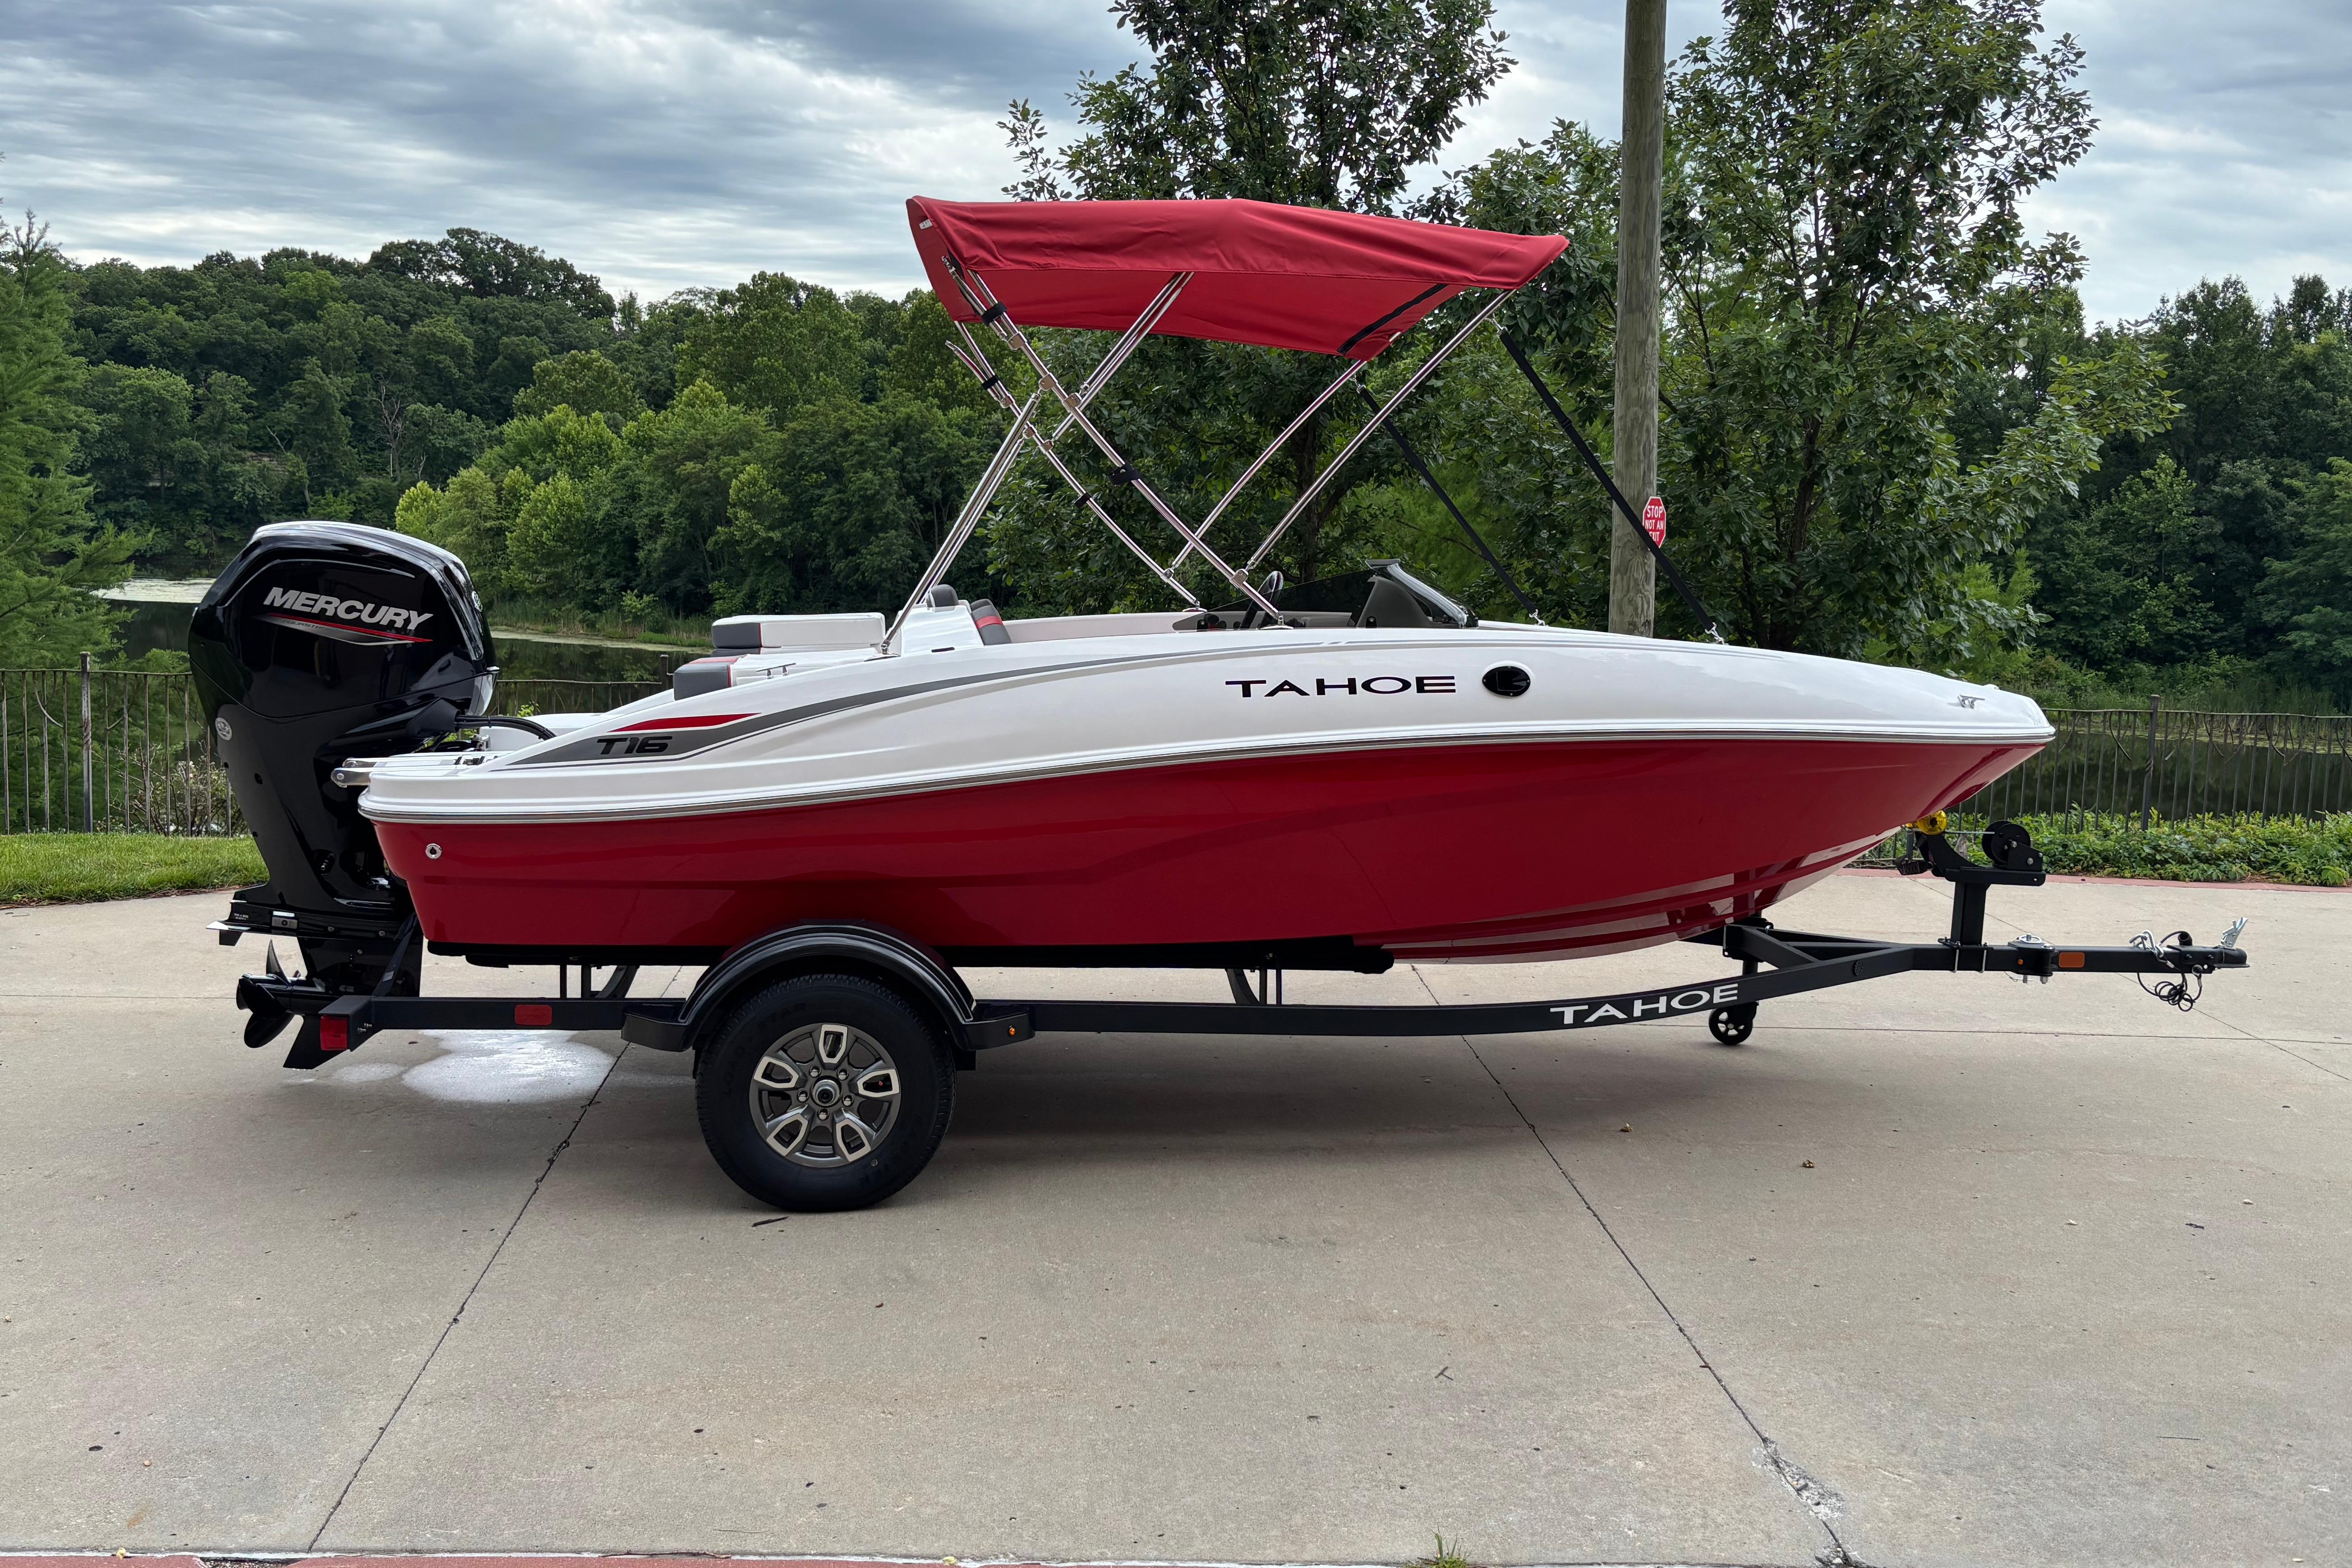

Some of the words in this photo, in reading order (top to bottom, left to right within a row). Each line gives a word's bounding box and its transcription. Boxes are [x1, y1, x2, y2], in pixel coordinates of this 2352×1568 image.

[1647, 506, 1663, 518] STOP
[1645, 520, 1655, 530] NOT
[1657, 520, 1664, 530] AN
[263, 587, 433, 630] MERCURY
[1225, 676, 1456, 698] TAHOE
[597, 736, 673, 755] T16
[1550, 983, 1739, 1024] TAHOE
[757, 1002, 809, 1032] STAR
